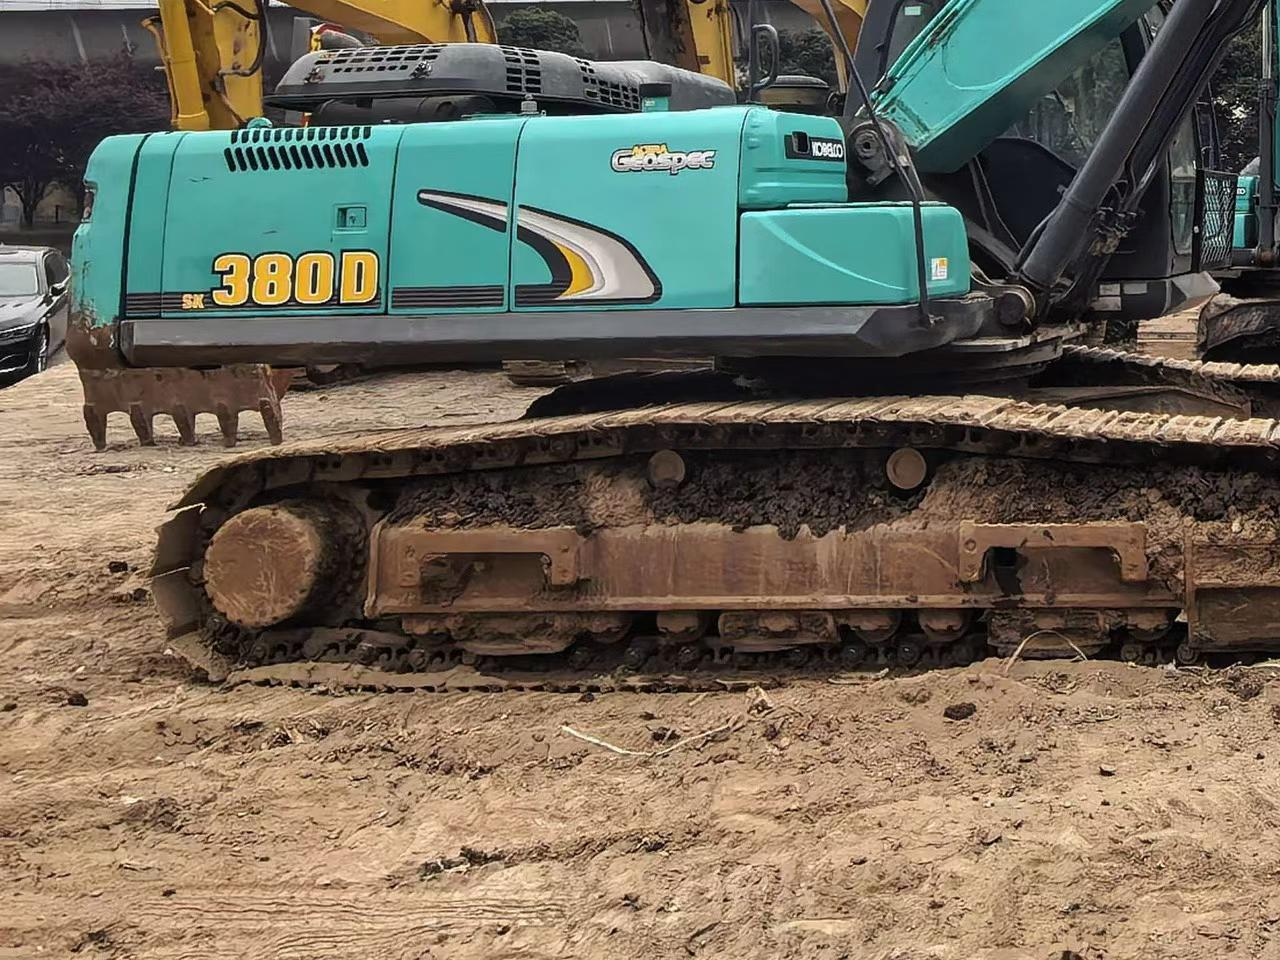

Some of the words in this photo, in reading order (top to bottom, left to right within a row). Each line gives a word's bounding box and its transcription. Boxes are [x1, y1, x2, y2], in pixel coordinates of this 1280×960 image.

[611, 149, 716, 175] Geospec
[182, 292, 205, 310] SK
[211, 250, 380, 307] 380D
